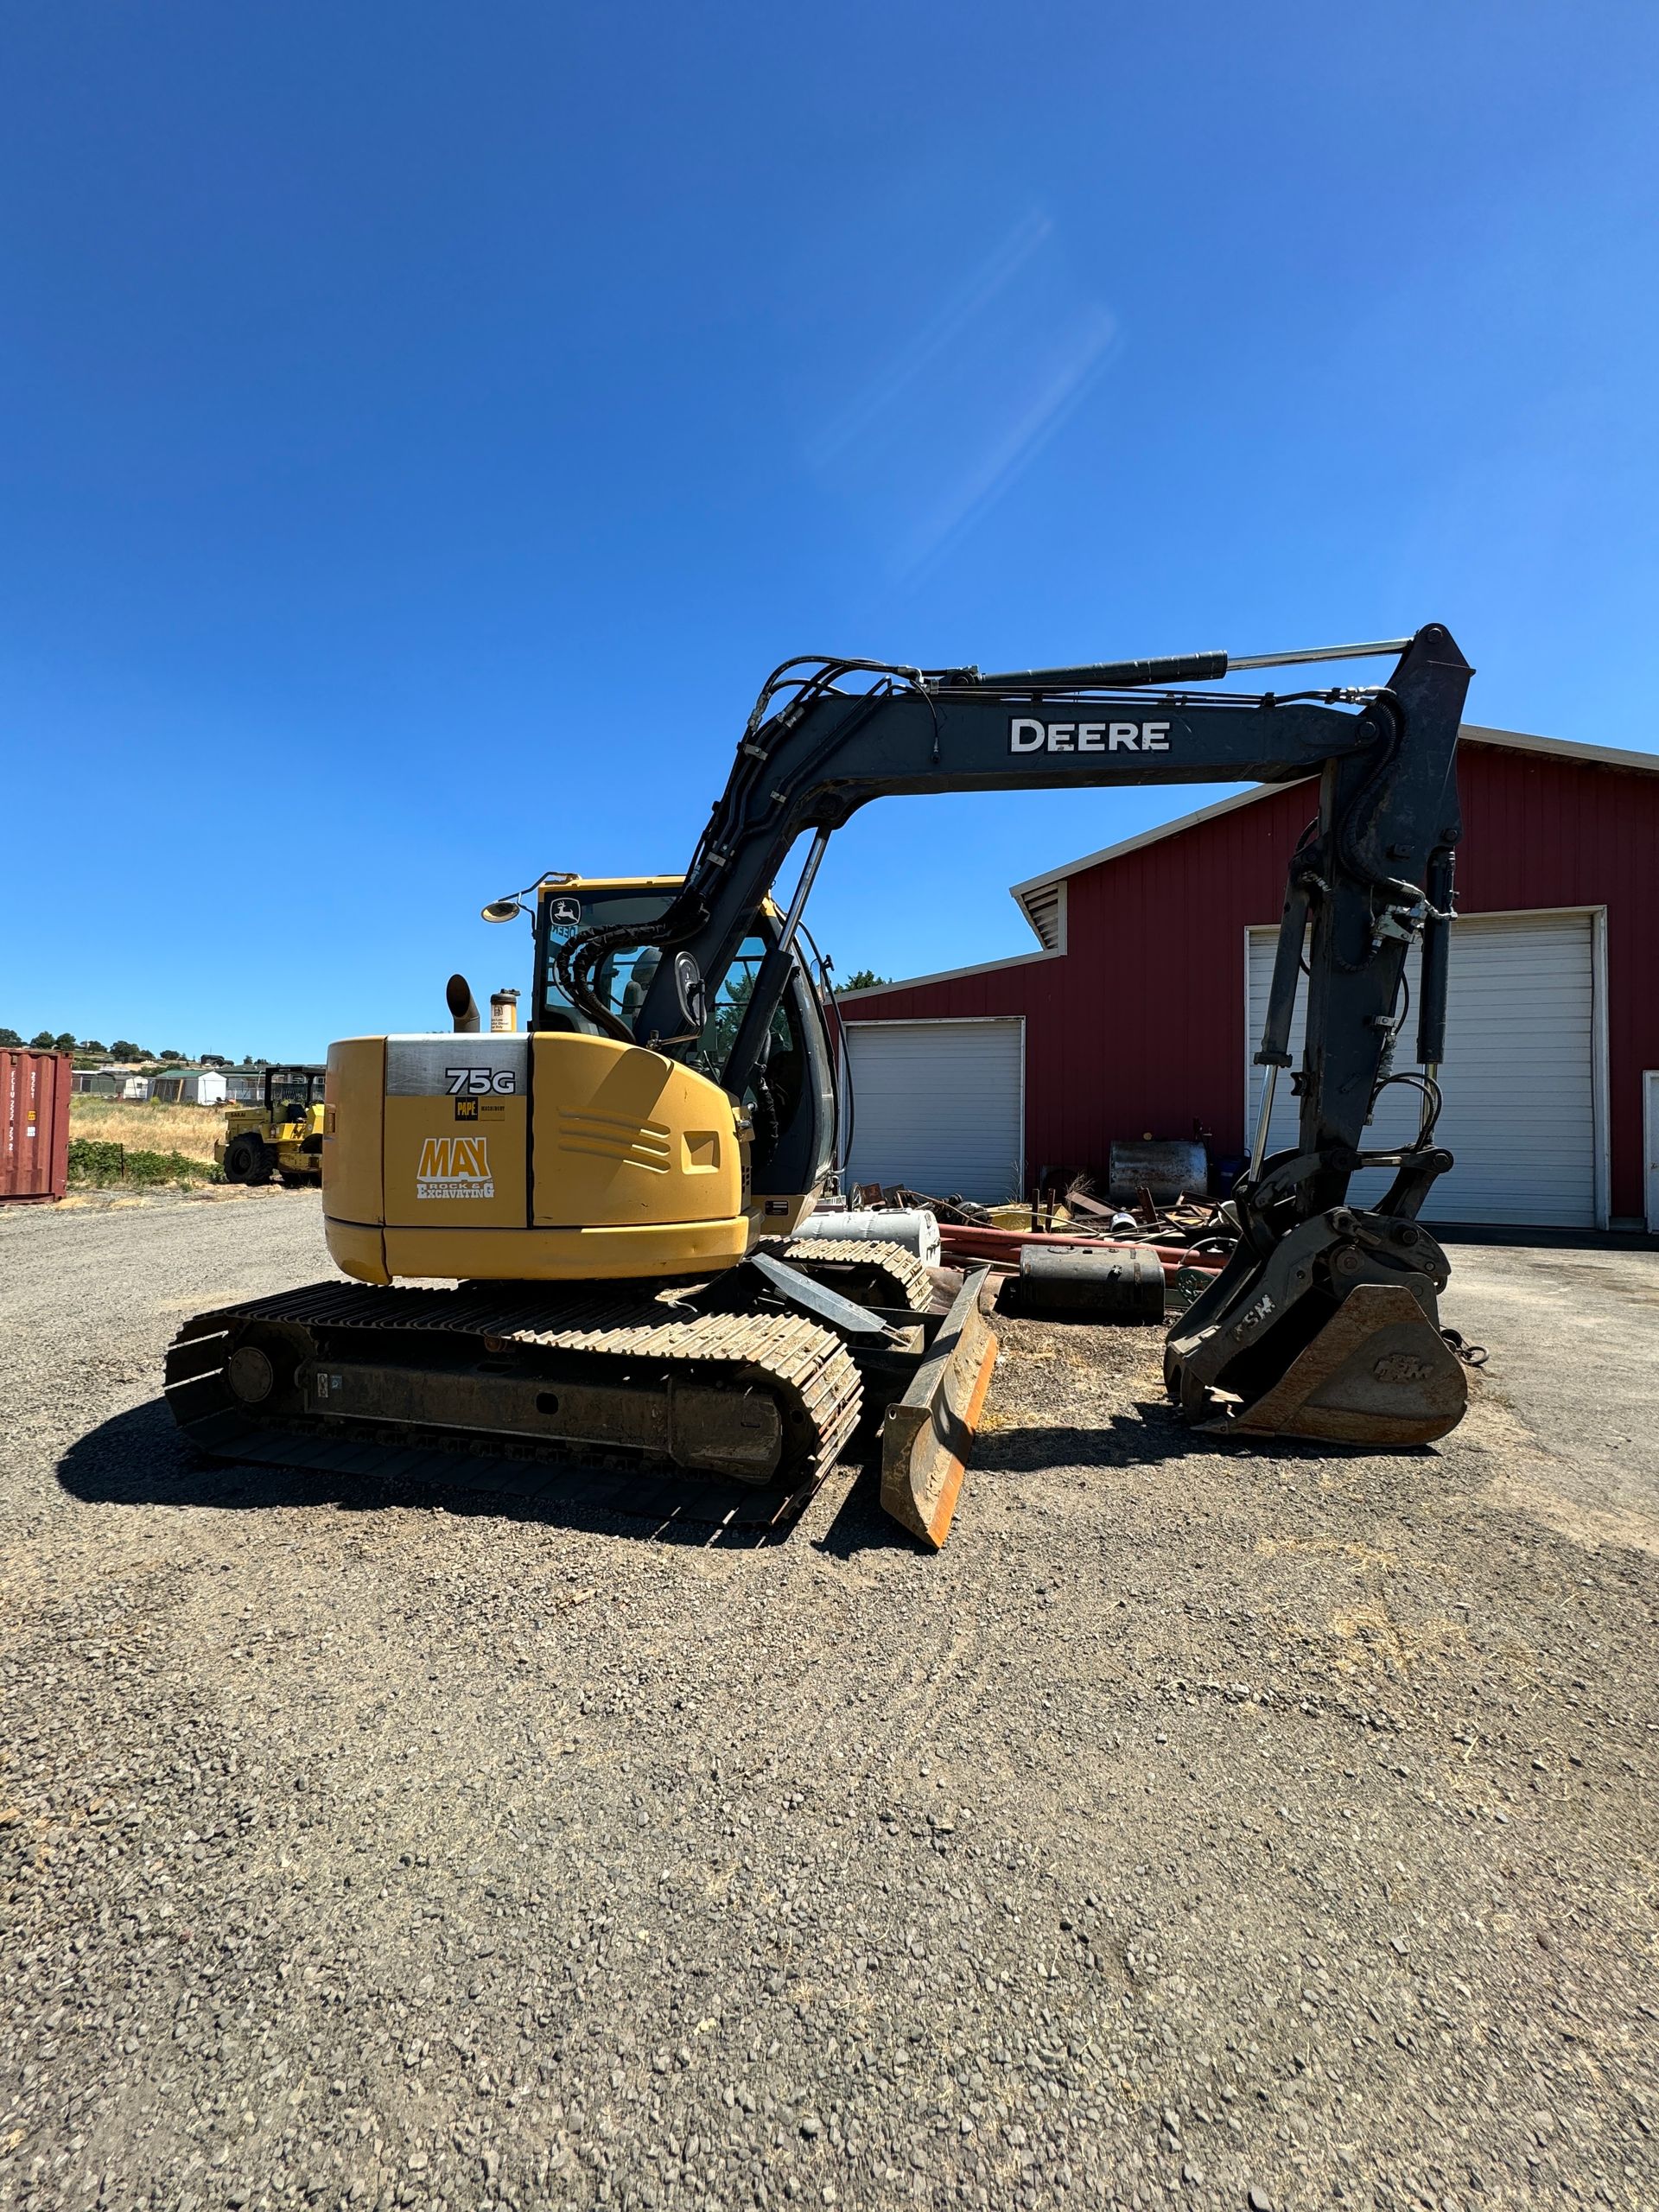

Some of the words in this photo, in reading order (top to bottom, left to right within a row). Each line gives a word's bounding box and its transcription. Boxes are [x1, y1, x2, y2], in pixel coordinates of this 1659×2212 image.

[1010, 718, 1170, 753] DEERE
[445, 1067, 516, 1096] 75G
[416, 1137, 492, 1182] MAY
[416, 1183, 494, 1199] EXCAVATING
